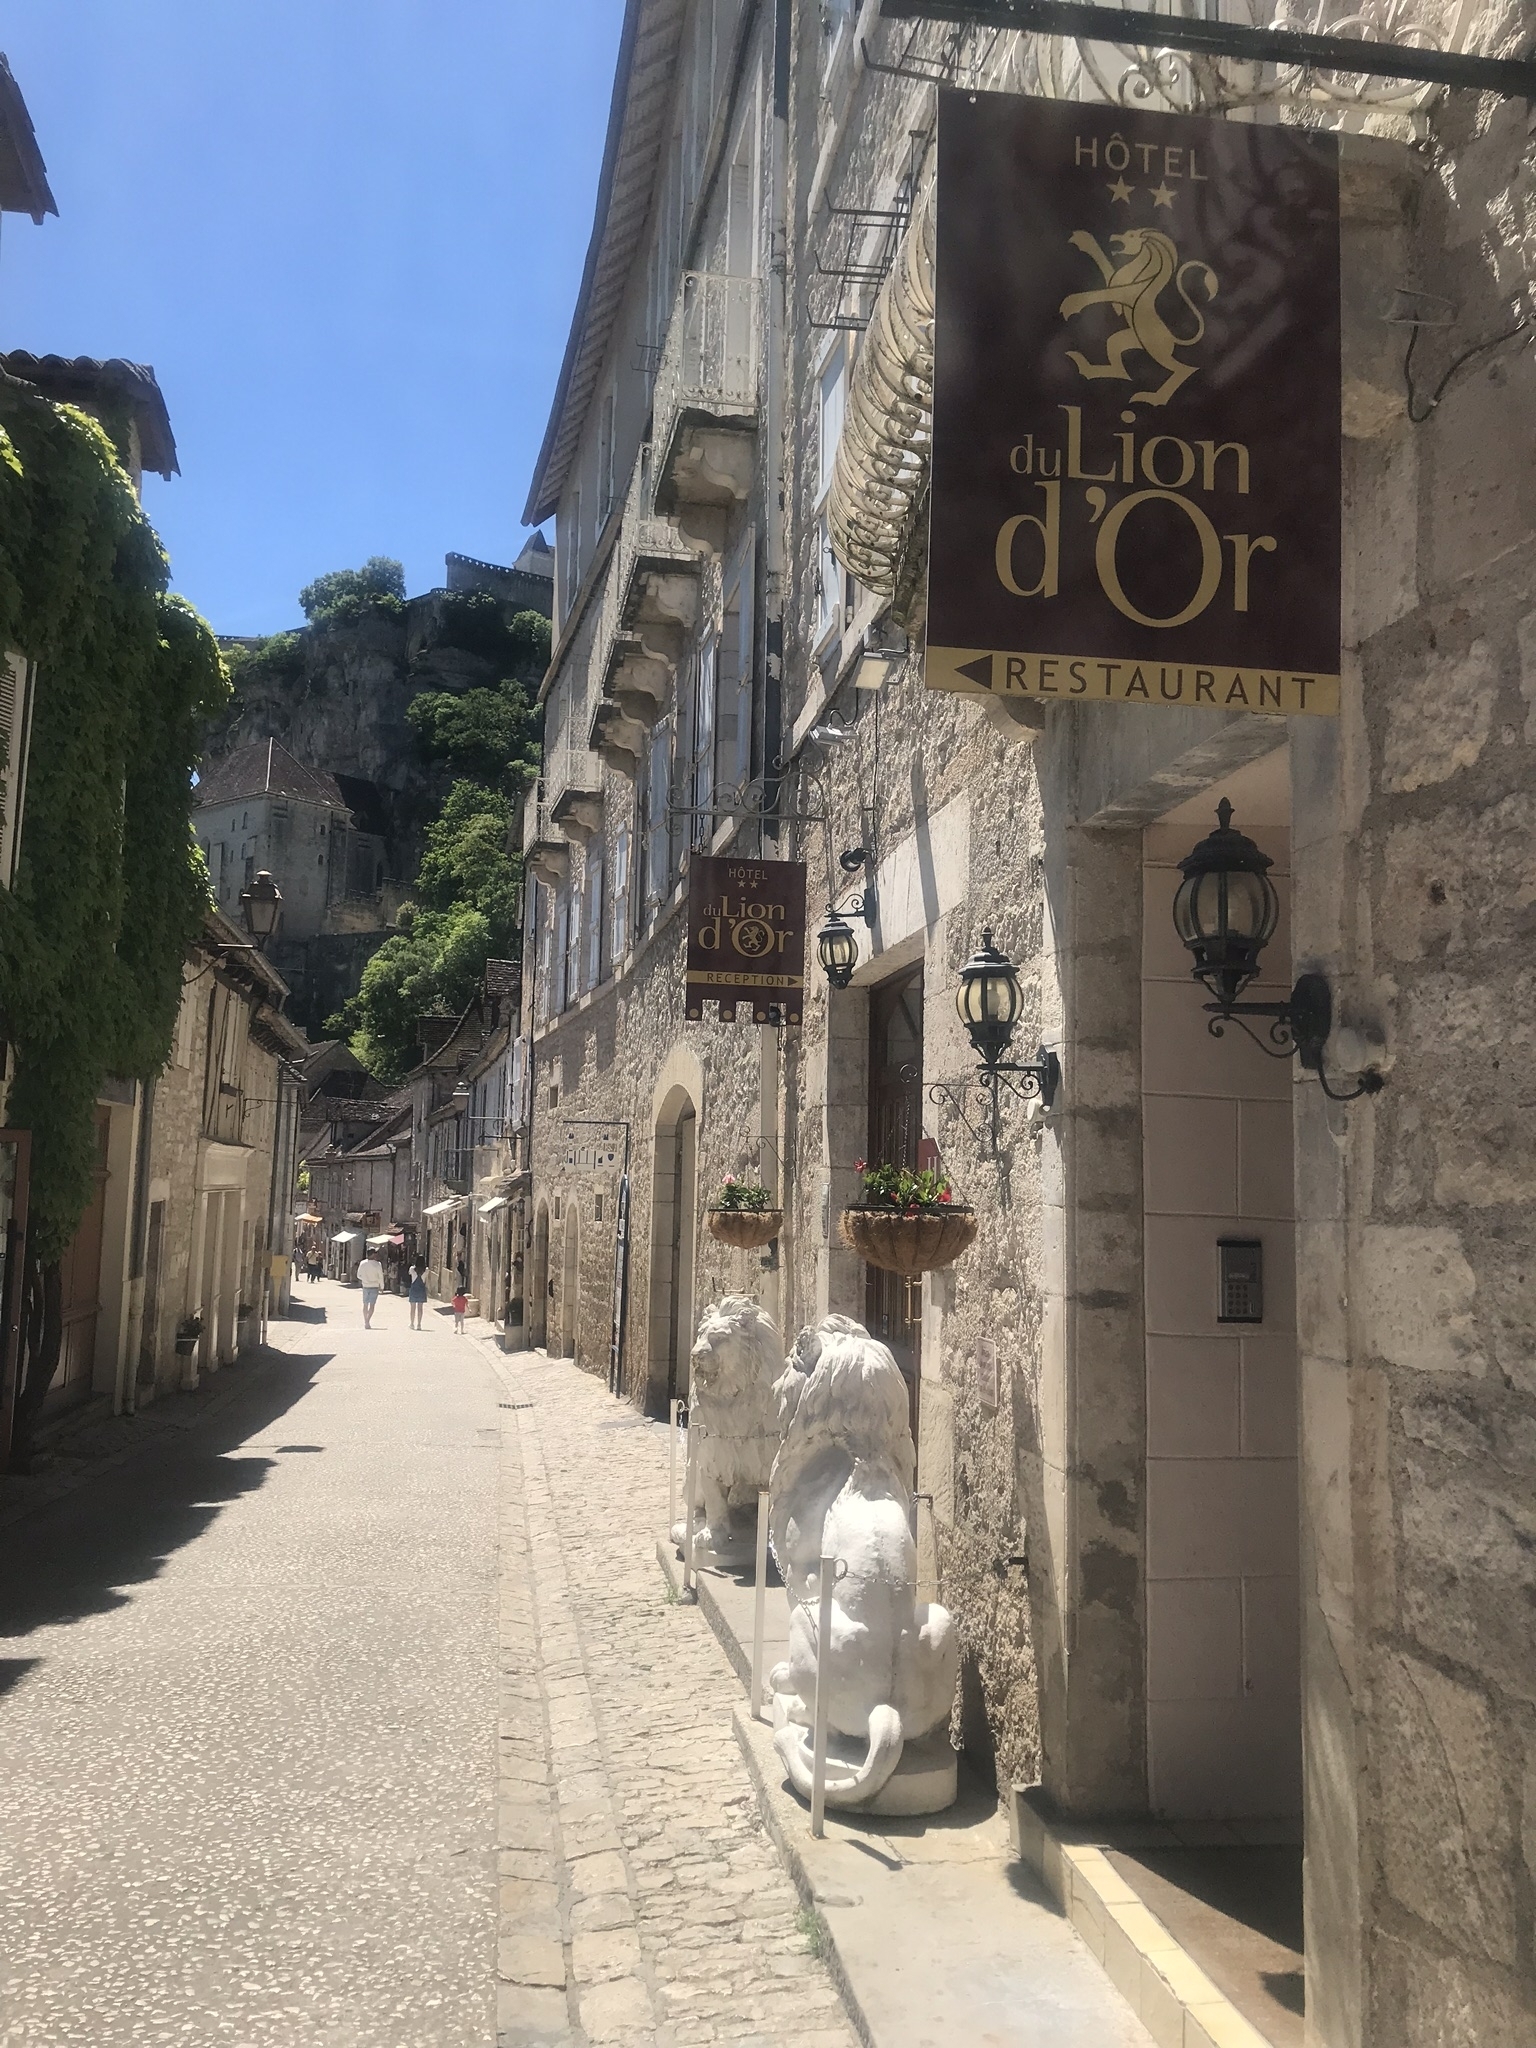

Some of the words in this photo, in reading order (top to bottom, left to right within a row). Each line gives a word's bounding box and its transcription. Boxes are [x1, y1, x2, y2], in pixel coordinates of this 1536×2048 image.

[1075, 133, 1208, 181] HÔTEL
[1010, 434, 1061, 478] du
[1058, 404, 1251, 494] Lion
[1005, 656, 1316, 709] RESTAURANT
[728, 866, 768, 880] HÔTEL
[703, 904, 721, 916] du
[720, 895, 785, 920] Lion
[706, 972, 785, 986] RECEPTION
